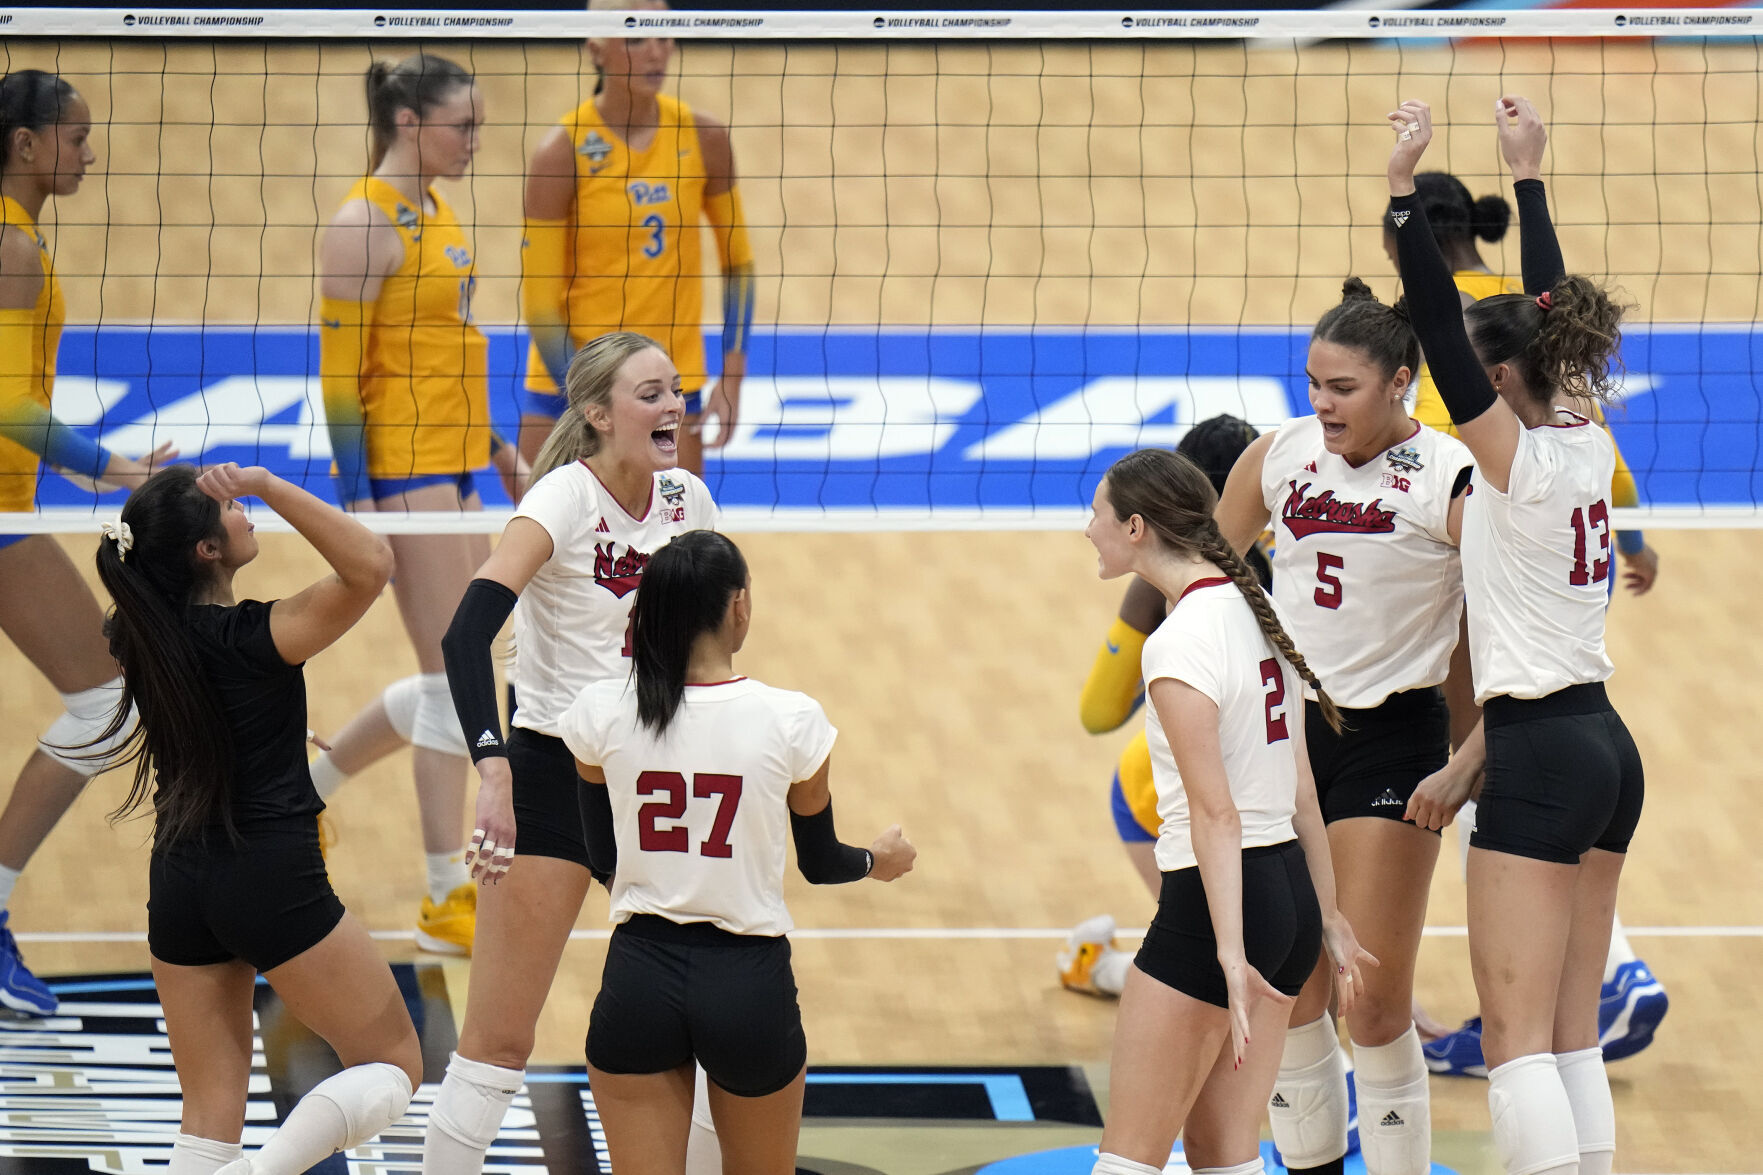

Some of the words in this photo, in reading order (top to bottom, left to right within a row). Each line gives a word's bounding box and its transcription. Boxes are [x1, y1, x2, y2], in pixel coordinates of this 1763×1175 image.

[137, 16, 190, 25] VOLLEYBALL
[193, 16, 264, 25] CHAMPIONSHIP
[387, 17, 440, 27] VOLLEYBALL
[443, 17, 513, 26] CHAMPIONSHIP
[639, 18, 690, 27] VOLLEYBALL
[693, 18, 764, 26] CHAMPIONSHIP
[888, 18, 938, 27] VOLLEYBALL
[942, 18, 1011, 26] CHAMPIONSHIP
[1134, 18, 1186, 27] VOLLEYBALL
[1190, 17, 1259, 26] CHAMPIONSHIP
[1383, 17, 1433, 26] VOLLEYBALL
[1437, 17, 1505, 26] CHAMPIONSHIP
[1629, 16, 1679, 25] VOLLEYBALL
[1683, 15, 1752, 25] CHAMPIONSHIP
[642, 213, 664, 259] 3
[1282, 479, 1398, 533] Nebraska
[1569, 499, 1611, 586] 13
[1313, 551, 1344, 610] 5
[1259, 656, 1290, 745] 2
[476, 739, 499, 748] adidas
[636, 770, 744, 859] 27
[1380, 1119, 1405, 1127] adidas
